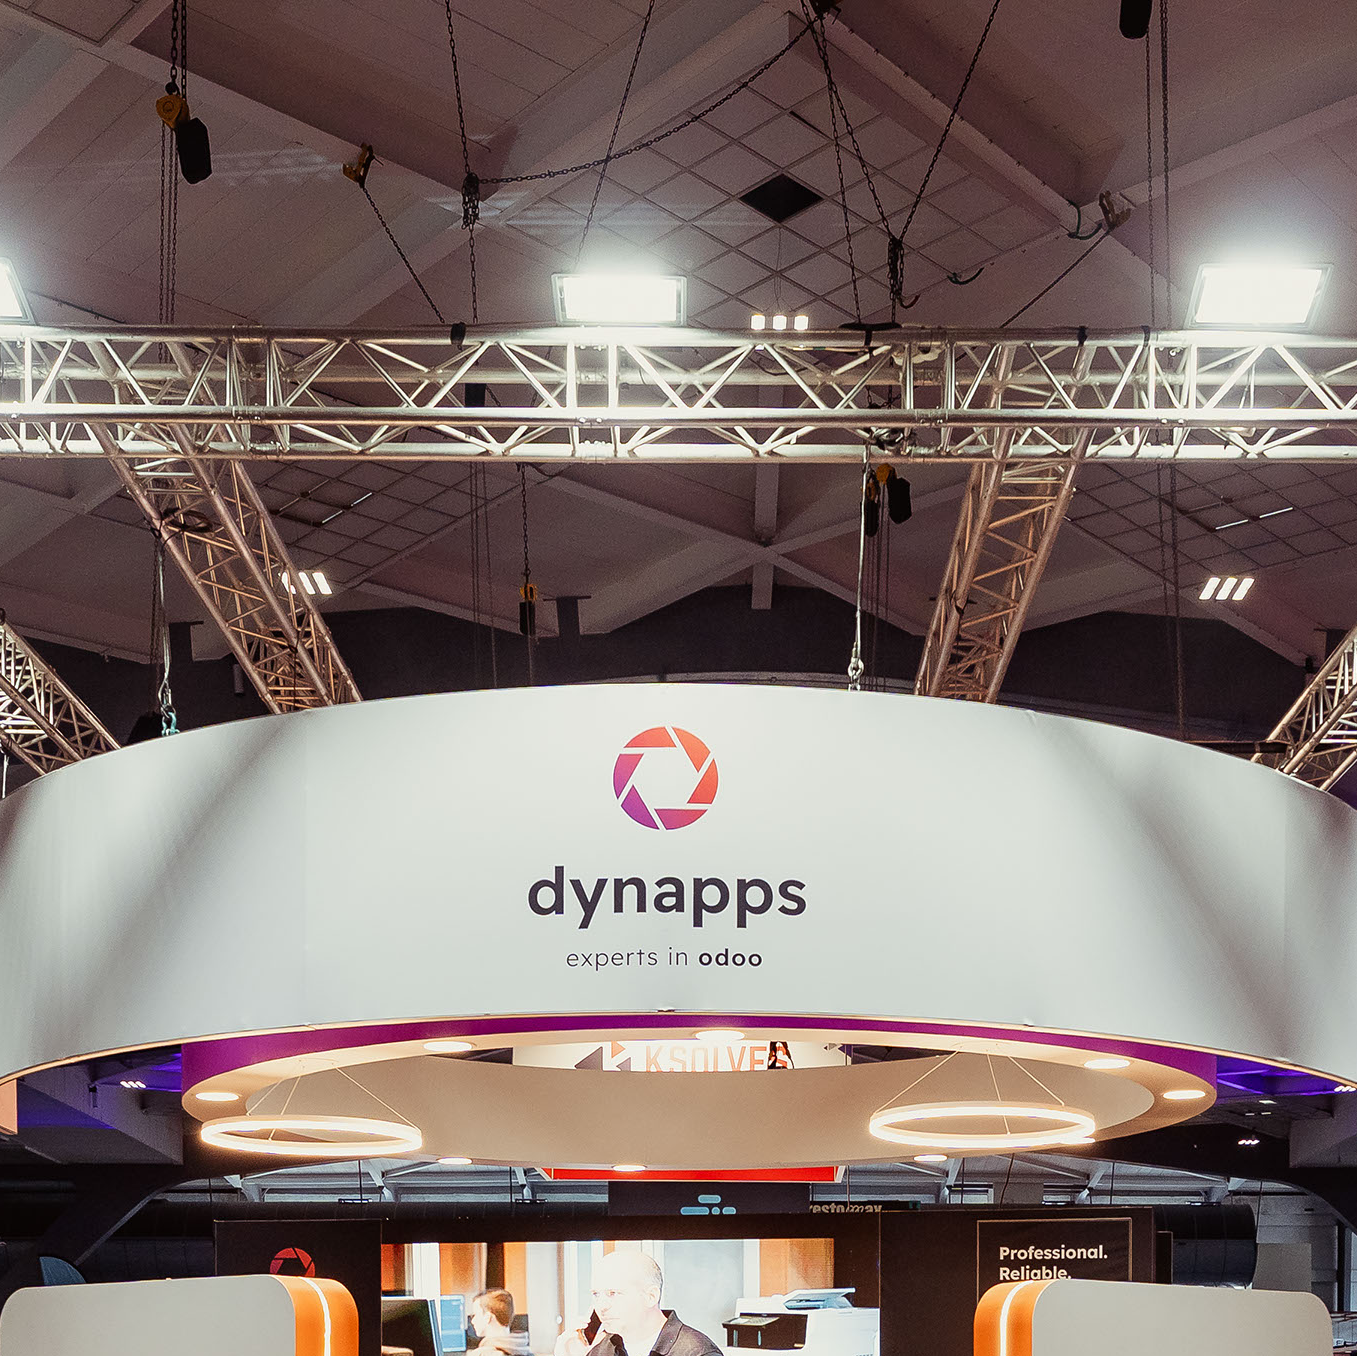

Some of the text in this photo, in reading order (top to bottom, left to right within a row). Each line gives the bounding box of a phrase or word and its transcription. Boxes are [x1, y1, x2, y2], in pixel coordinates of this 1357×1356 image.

[528, 865, 806, 930] dynapps
[566, 946, 762, 971] experts in odoo
[999, 1245, 1108, 1260] Professional.
[999, 1265, 1072, 1281] Reliable.
